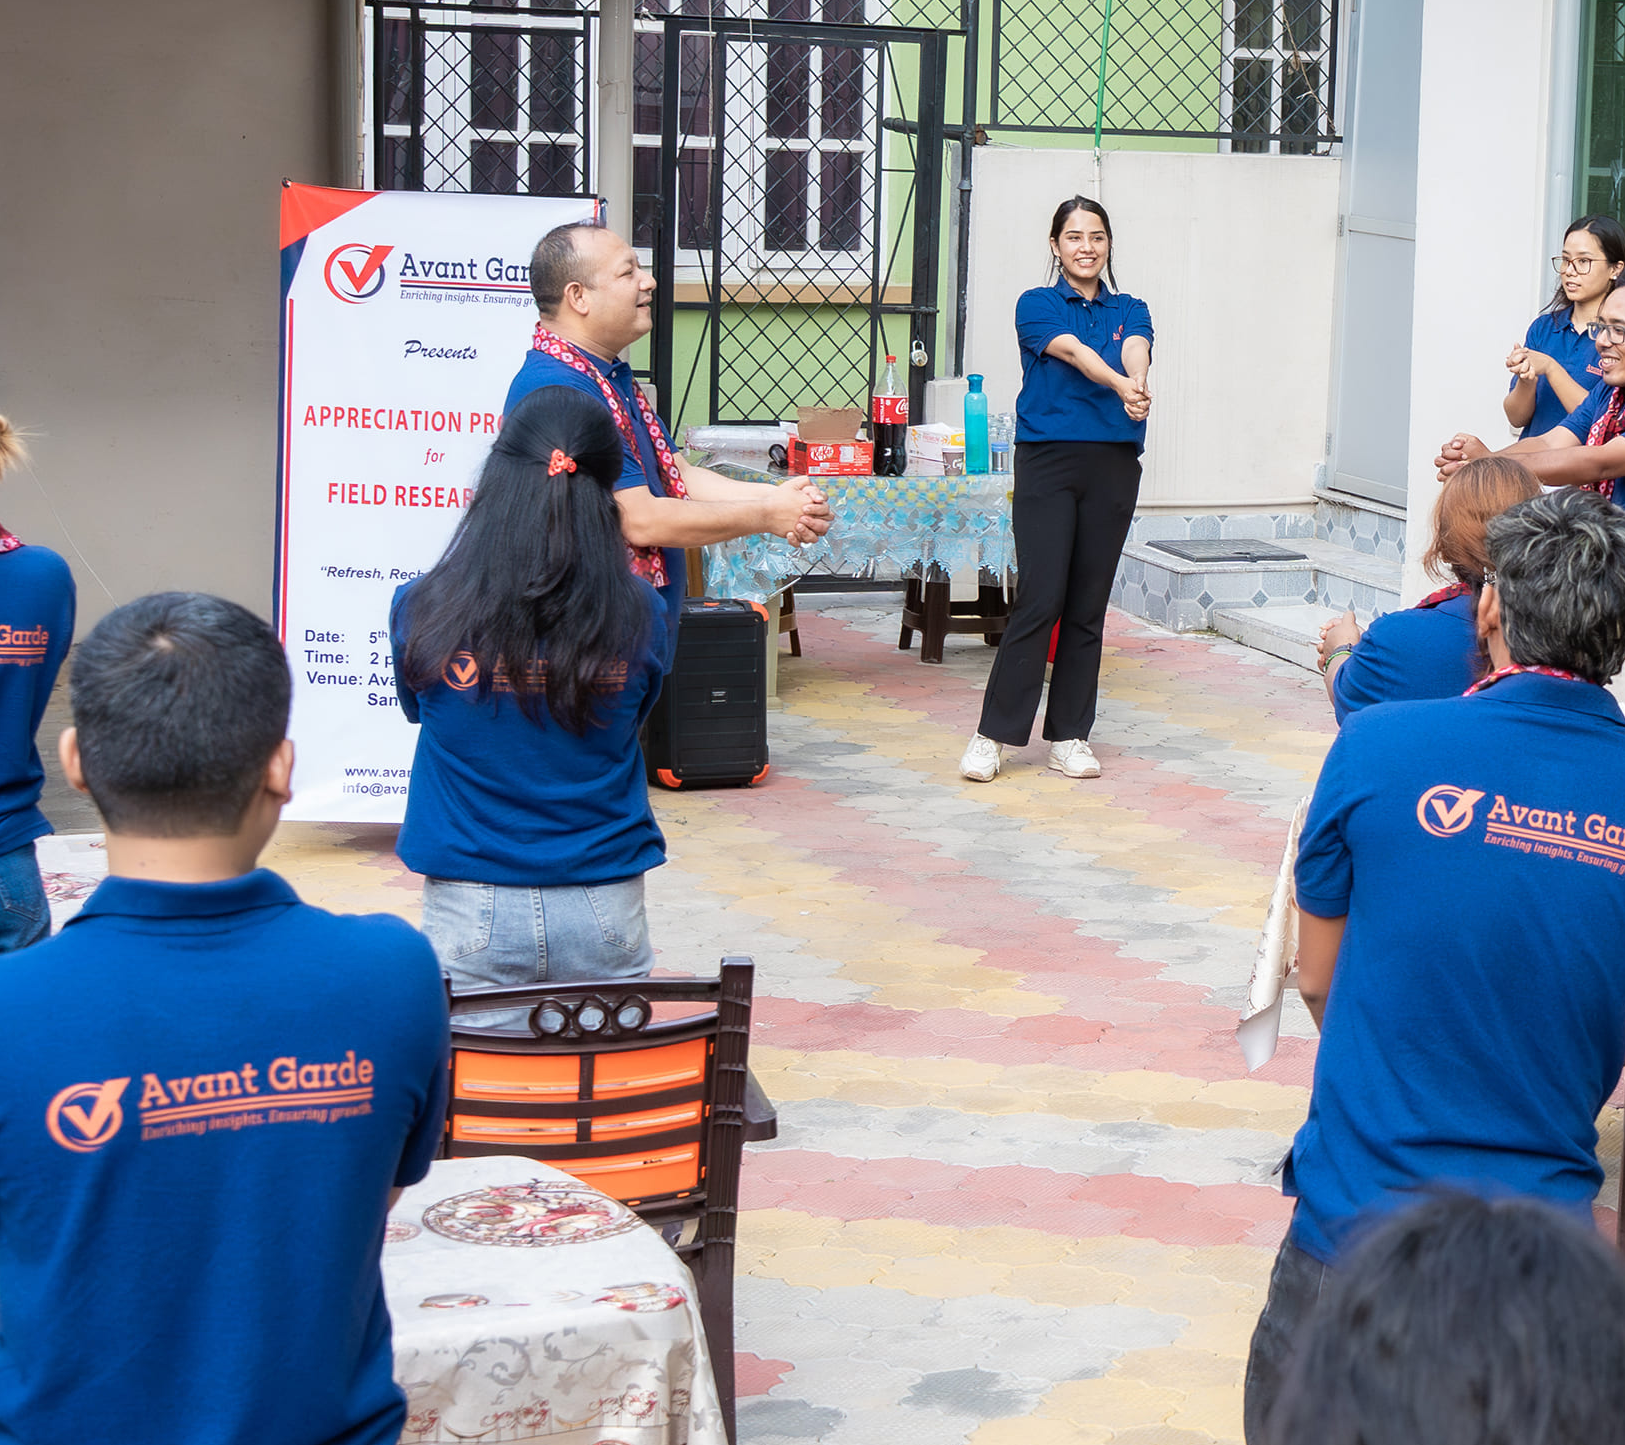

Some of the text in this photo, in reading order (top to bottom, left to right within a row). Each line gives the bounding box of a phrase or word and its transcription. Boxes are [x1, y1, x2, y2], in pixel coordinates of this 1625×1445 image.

[399, 253, 531, 282] Avant Gar
[400, 290, 443, 303] Enriching
[444, 291, 481, 305] insights.
[483, 293, 522, 307] Ensuring
[404, 339, 478, 360] Presents
[303, 405, 462, 433] APPRECIATION
[424, 448, 445, 465] for
[328, 483, 475, 509] FIELD RESEAR
[305, 629, 388, 644] Date: 5th
[304, 650, 350, 664] Time:
[369, 652, 379, 665] 2
[306, 671, 397, 687] Venue: Ava
[367, 692, 399, 707] San
[1486, 795, 1577, 835] Avant
[1484, 832, 1532, 853] Enriching
[1533, 840, 1575, 860] insights.
[1576, 852, 1619, 873] Ensuring
[138, 1050, 374, 1109] Avant Garde
